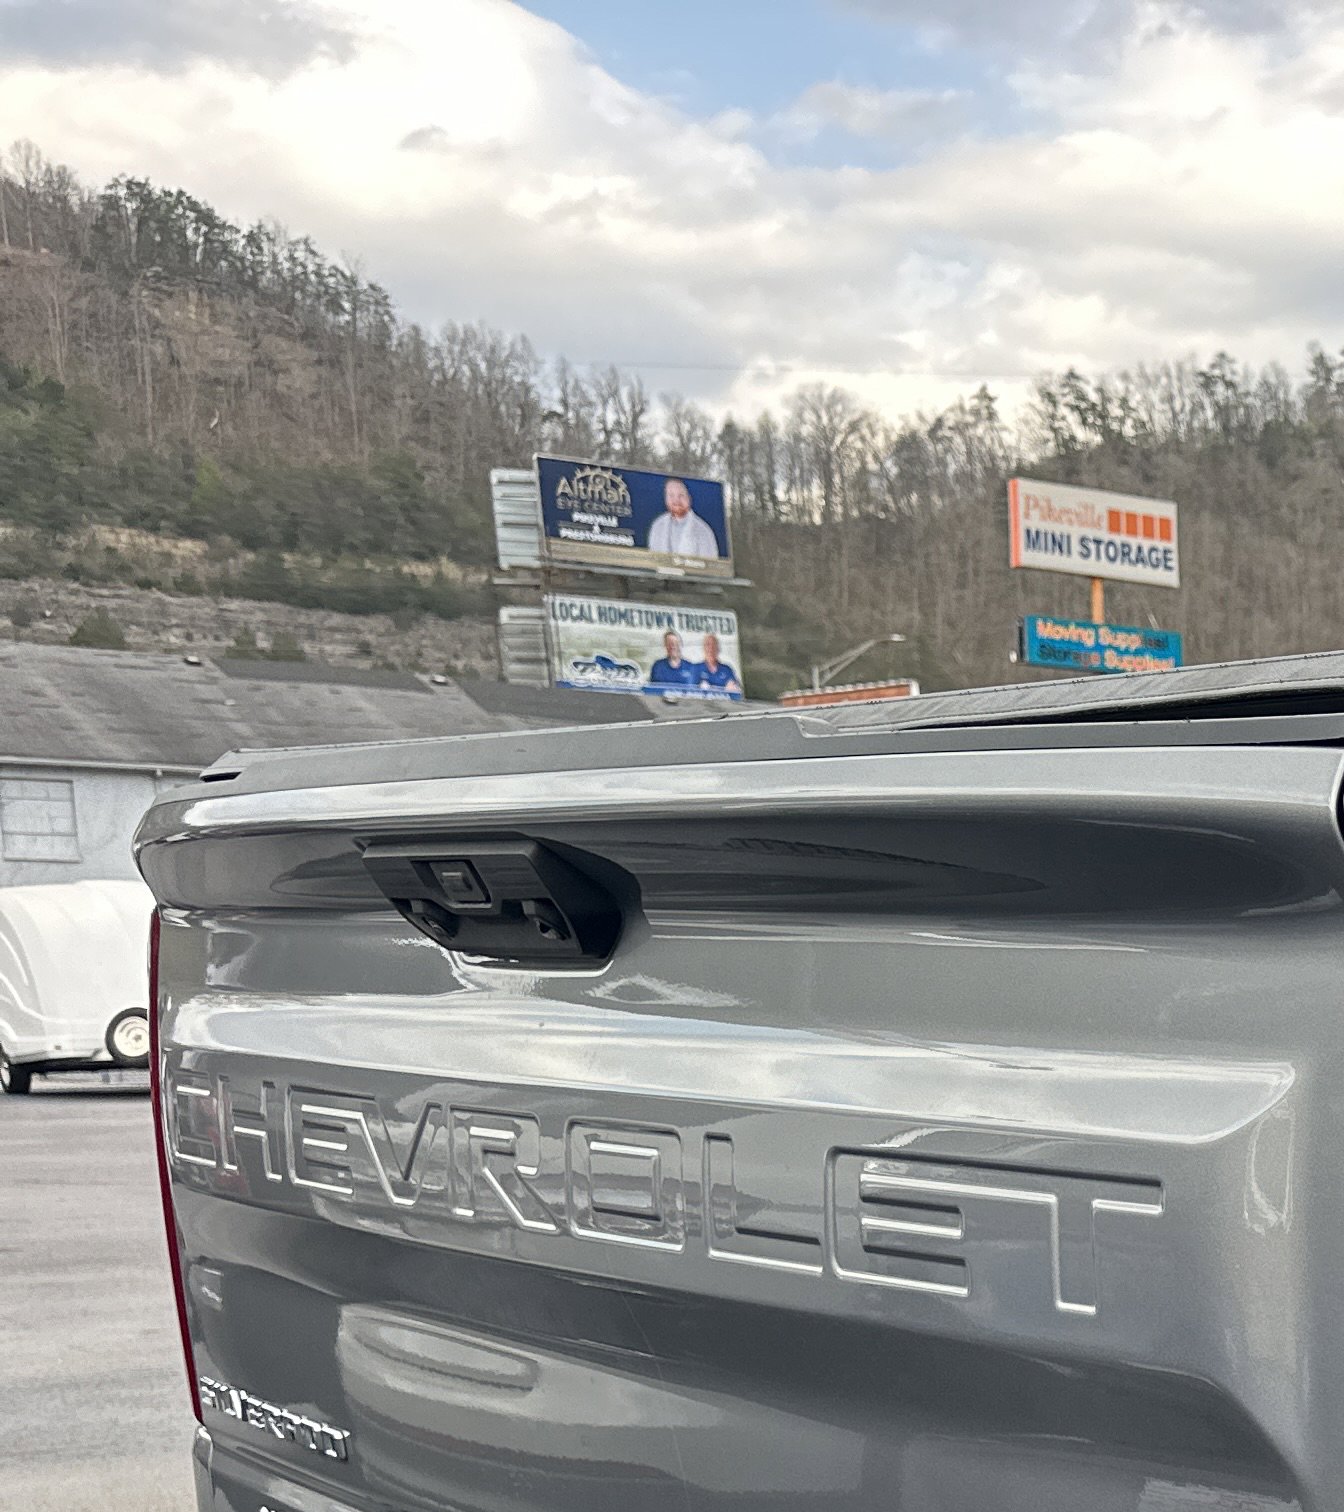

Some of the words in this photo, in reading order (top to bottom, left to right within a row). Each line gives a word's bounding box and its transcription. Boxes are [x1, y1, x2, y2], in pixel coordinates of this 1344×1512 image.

[1023, 494, 1105, 531] Pikeville
[1024, 528, 1073, 558] MINI
[1079, 534, 1175, 572] STORAGE
[551, 601, 594, 624] LOCAL
[597, 604, 676, 629] HOMETOWN
[678, 613, 736, 636] TRUSTED
[1036, 618, 1095, 647] Moving
[172, 1074, 1166, 1315] CHEVROLET
